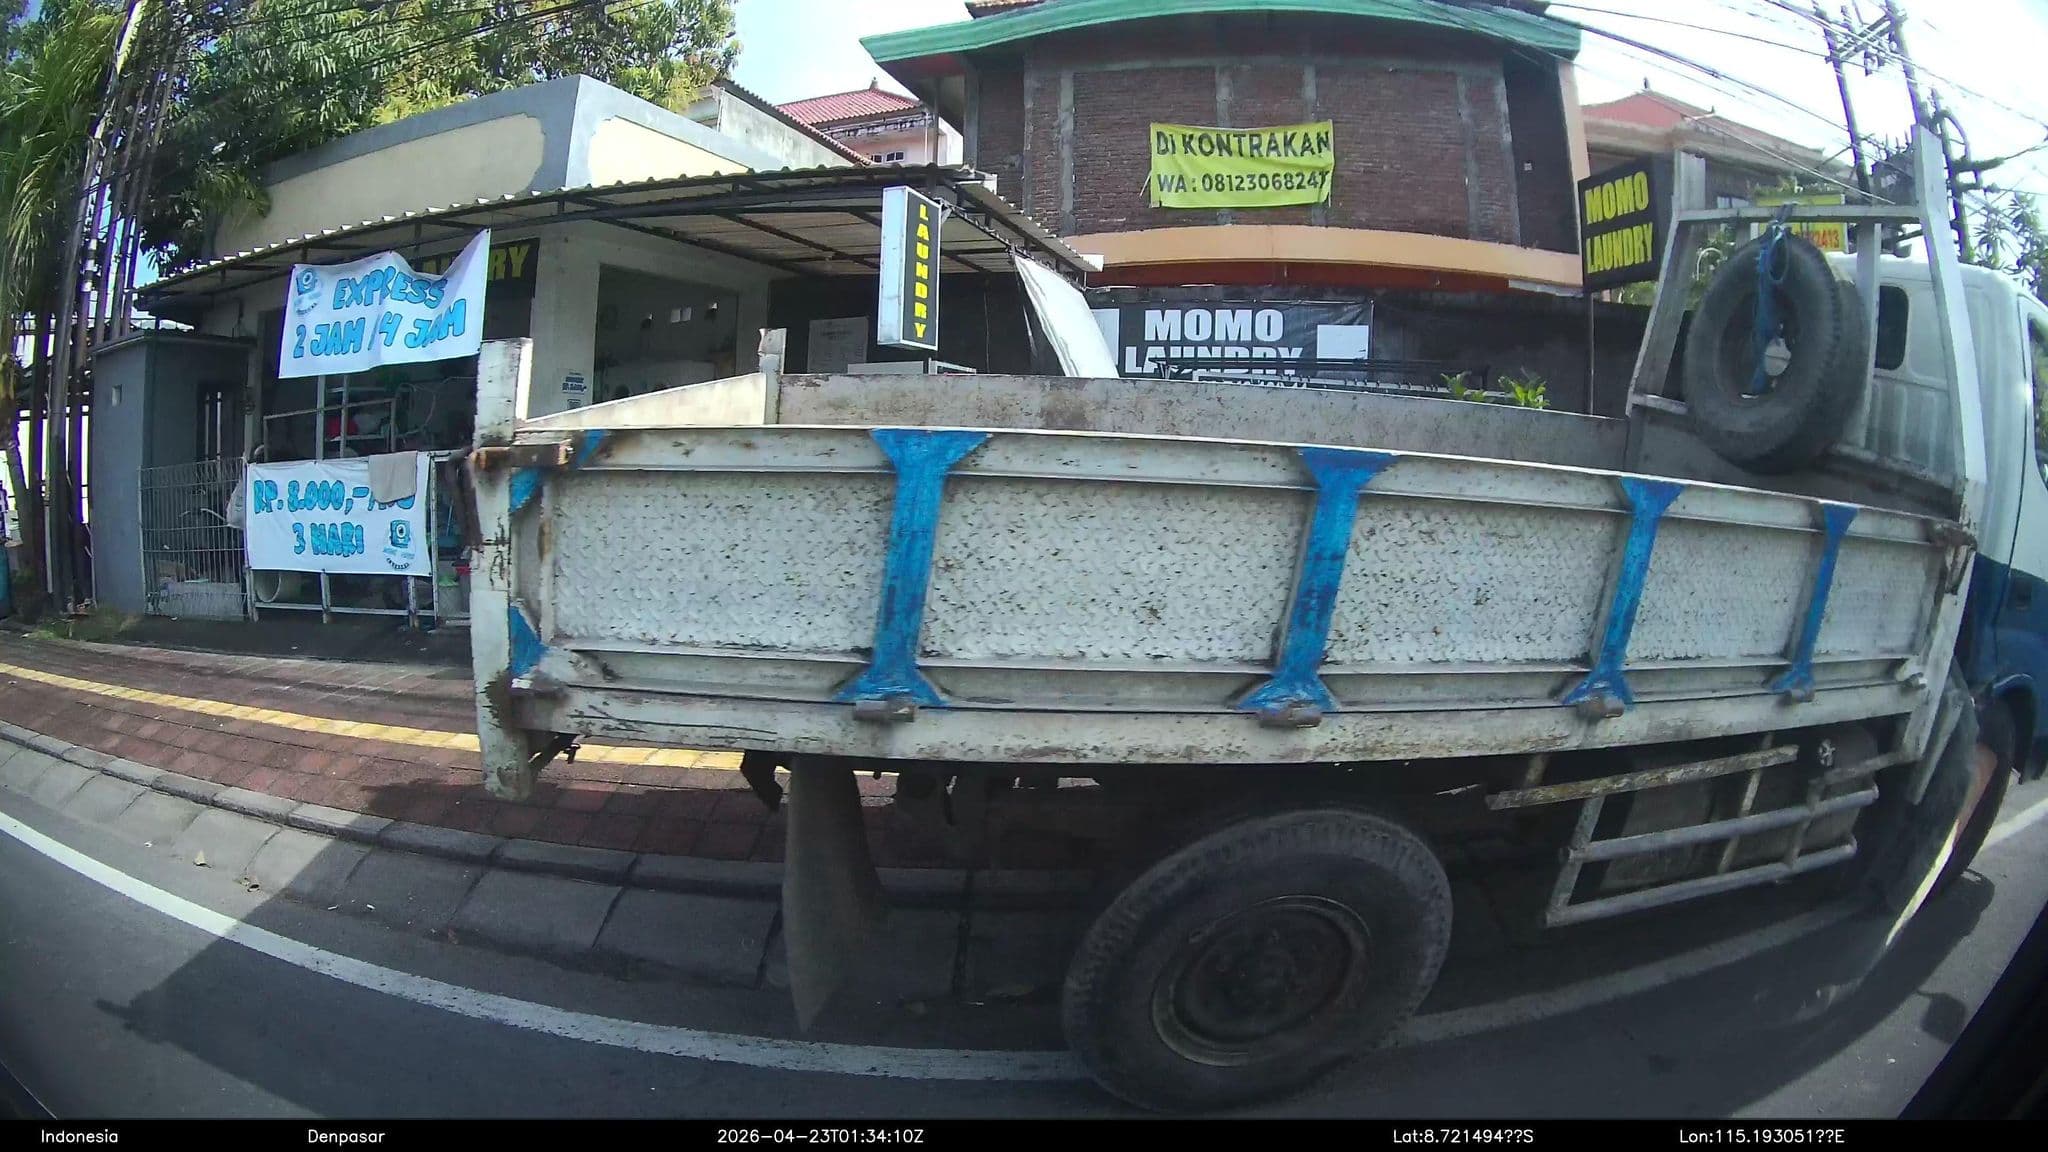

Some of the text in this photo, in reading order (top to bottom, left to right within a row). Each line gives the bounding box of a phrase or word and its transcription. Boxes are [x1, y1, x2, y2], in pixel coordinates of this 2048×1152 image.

[1182, 131, 1330, 157] KONTRAKAN
[1585, 171, 1649, 224] MOMO
[914, 203, 928, 338] LAUNDRY
[1586, 222, 1653, 274] LAUNDRY
[333, 266, 448, 310] EXPRESS
[293, 324, 307, 359] 2
[310, 317, 366, 356] JAM
[379, 311, 401, 347] 4
[404, 298, 467, 349] JAM
[1144, 308, 1284, 342] MOMO
[292, 521, 365, 558] 3 HARI
